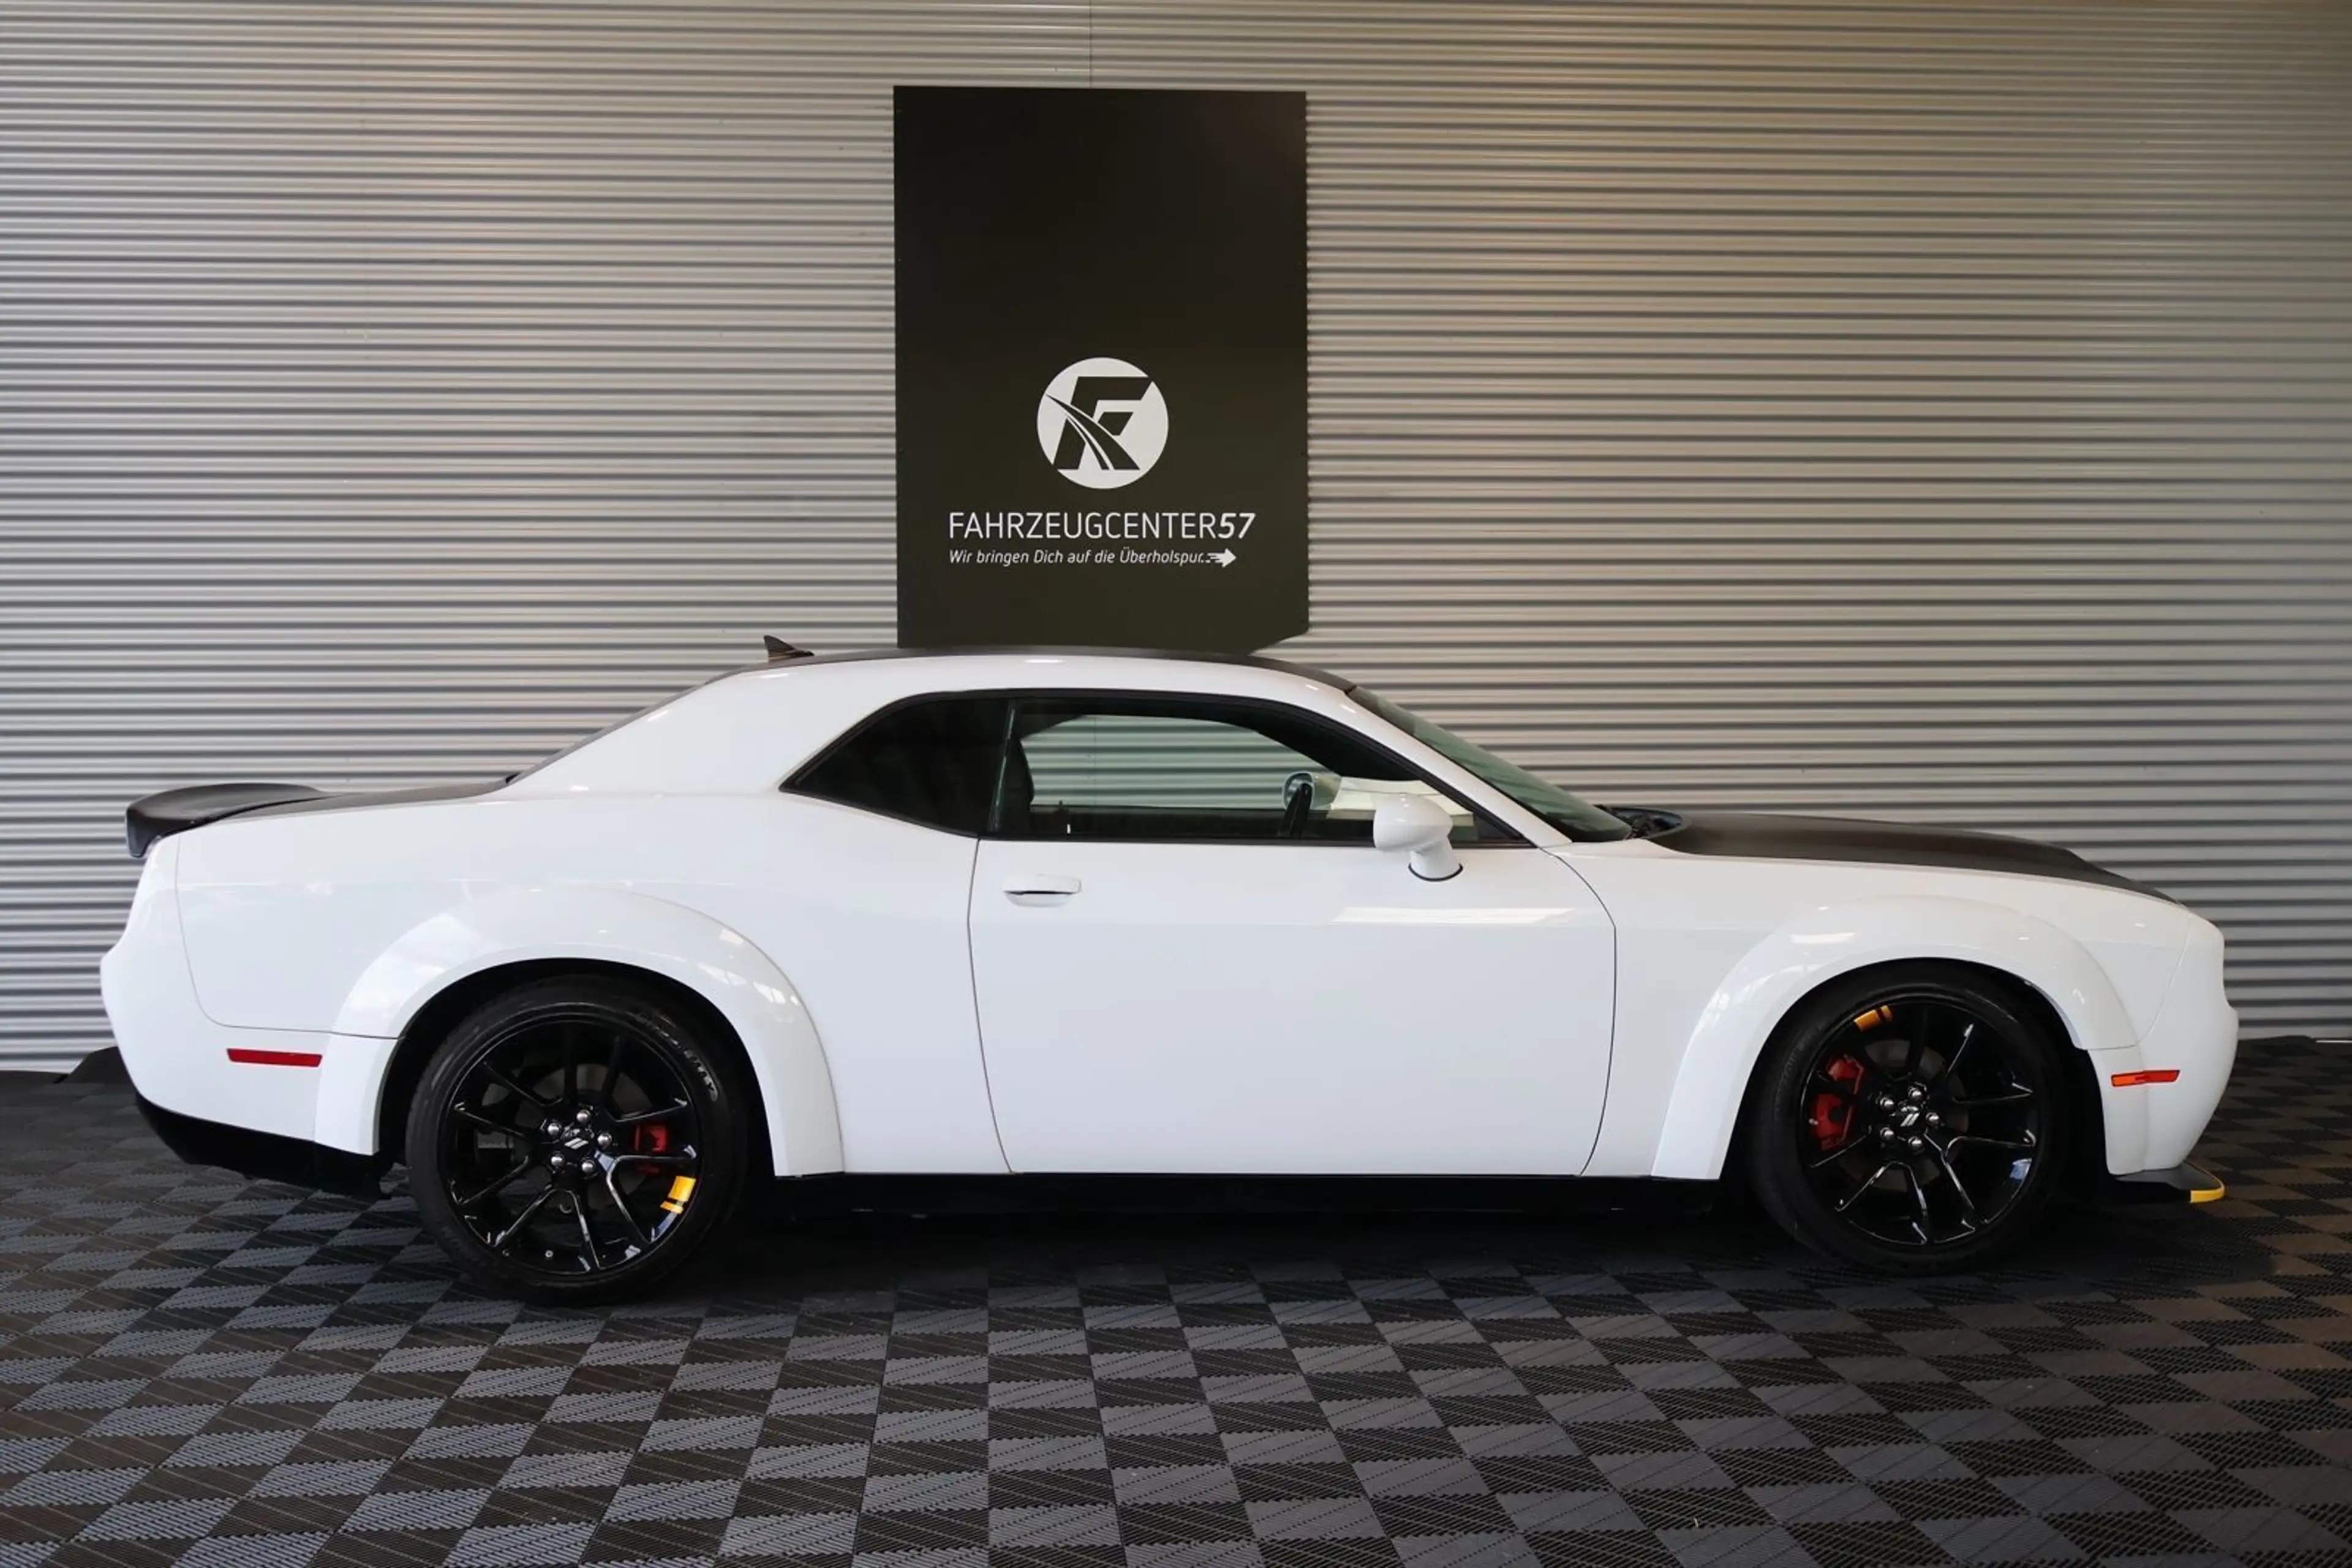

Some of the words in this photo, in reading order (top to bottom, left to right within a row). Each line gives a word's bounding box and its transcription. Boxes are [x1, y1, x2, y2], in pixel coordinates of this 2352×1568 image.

[949, 511, 1256, 539] FAHRZEUGCENTER57
[949, 549, 973, 564] Wir
[976, 549, 1030, 567] bringen
[1033, 549, 1064, 564] Dich
[1067, 549, 1092, 564] auf
[1095, 549, 1115, 564] die
